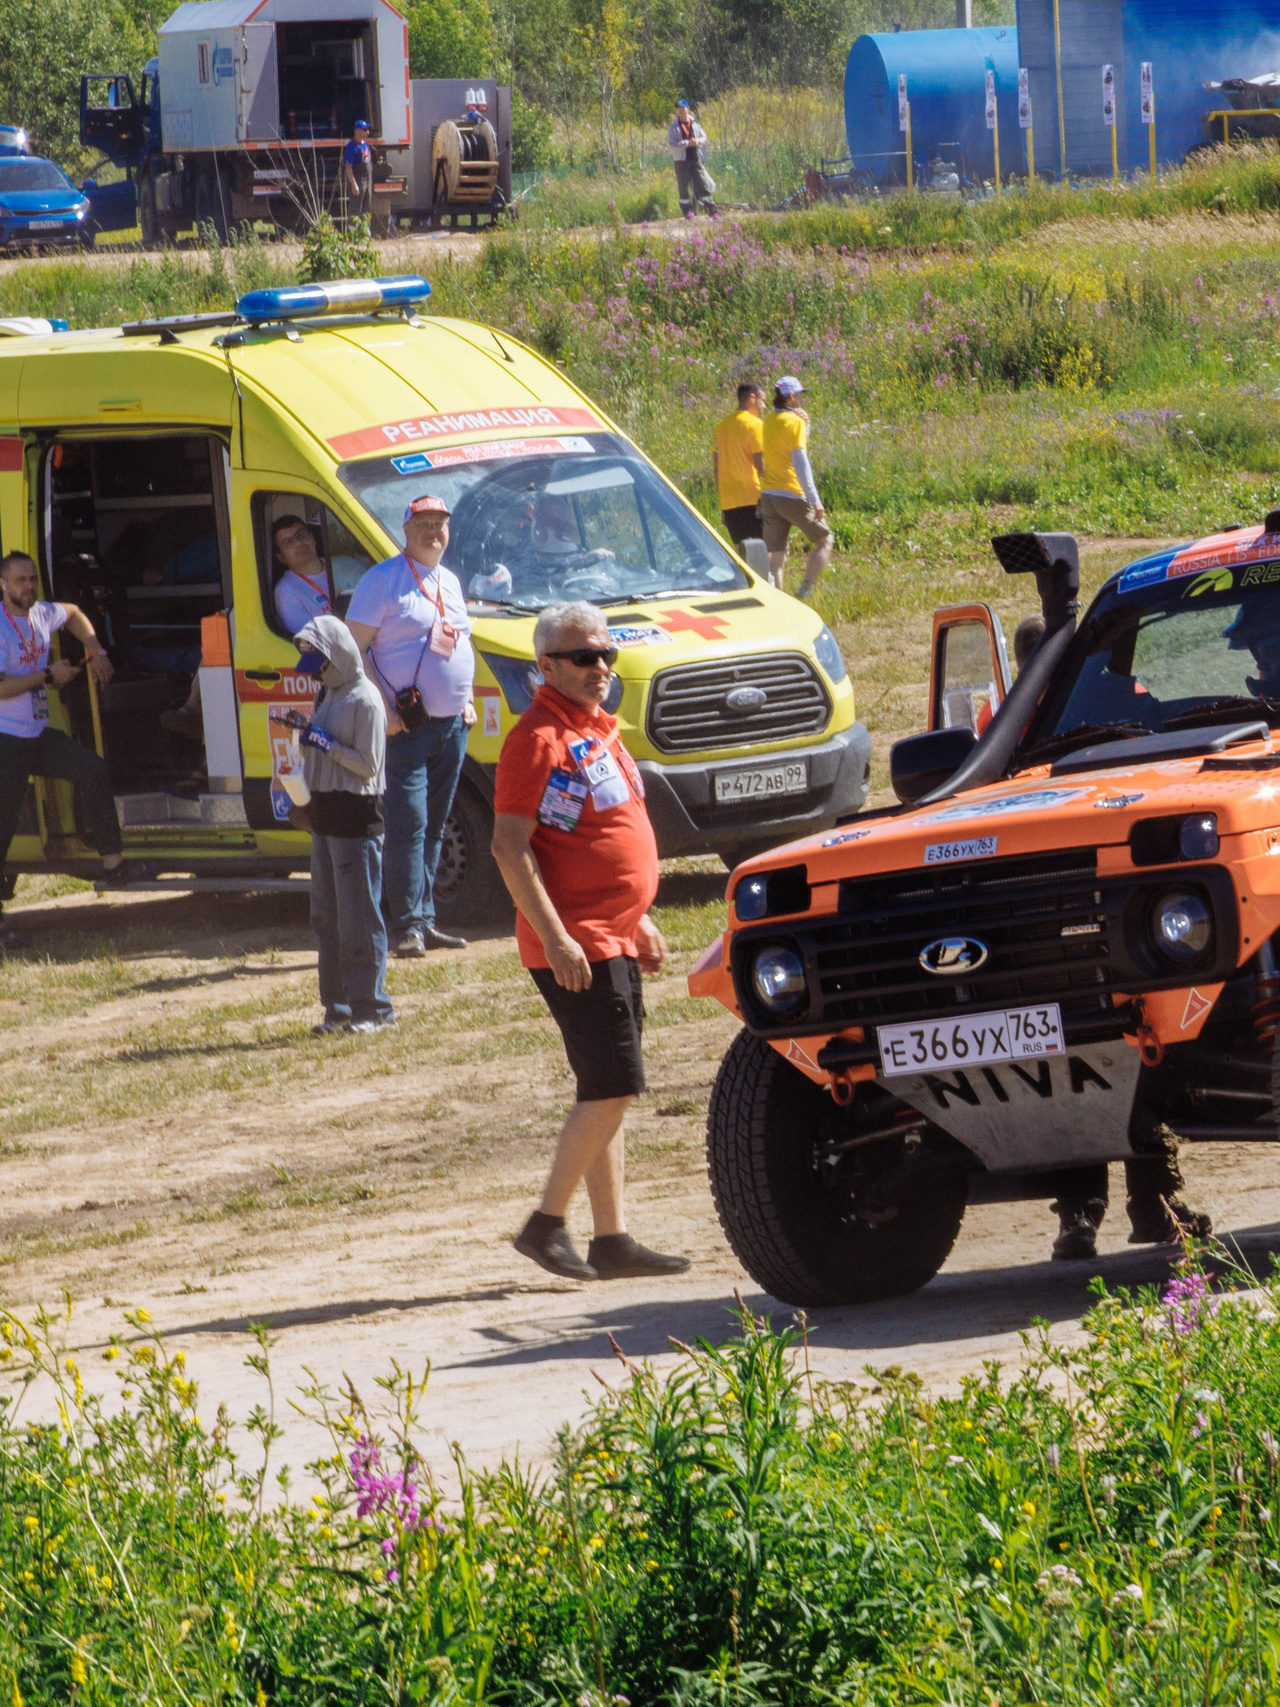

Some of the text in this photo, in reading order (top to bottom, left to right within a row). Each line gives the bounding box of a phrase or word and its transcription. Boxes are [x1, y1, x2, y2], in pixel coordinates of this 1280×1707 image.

[381, 407, 561, 443] РЕАНИМАЦИЯ
[1234, 537, 1266, 551] SILK
[1172, 553, 1221, 575] RUSSIA
[787, 764, 802, 781] 99
[976, 838, 994, 850] 763
[1061, 923, 1101, 936] SPORT
[1009, 1010, 1051, 1041] 763
[1022, 1042, 1043, 1053] RUS
[922, 1055, 1113, 1109] NIVA
